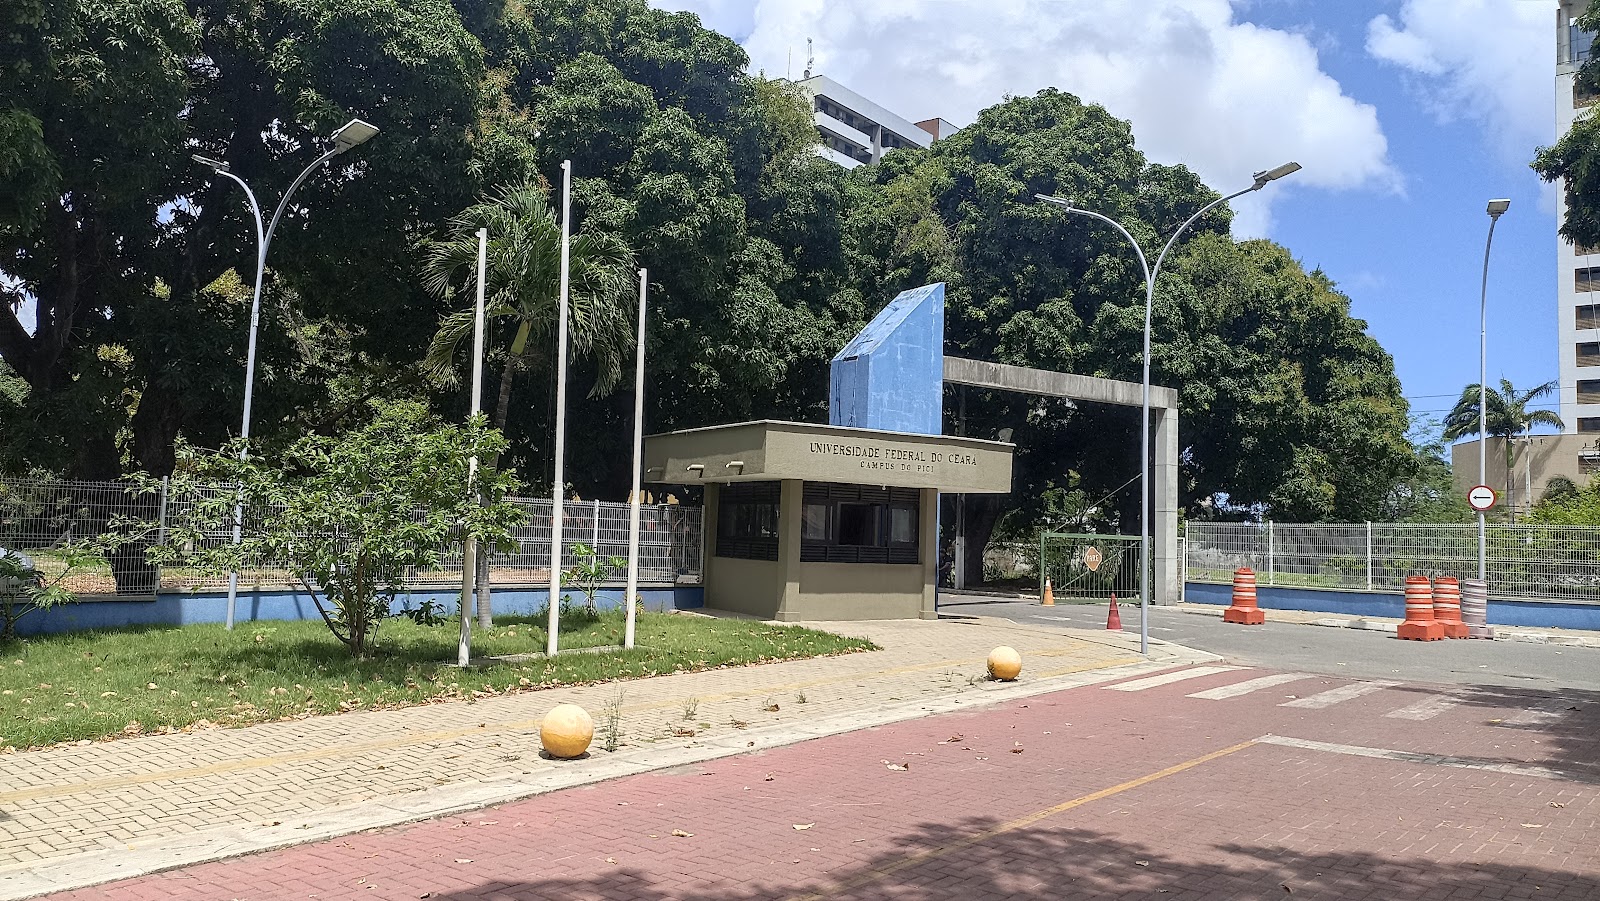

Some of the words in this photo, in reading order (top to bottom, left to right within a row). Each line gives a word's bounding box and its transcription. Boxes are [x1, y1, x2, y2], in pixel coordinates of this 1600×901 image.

[809, 442, 880, 458] UNIVERSIDADE
[885, 449, 926, 462] FEDERAL
[931, 452, 943, 463] DO
[860, 460, 895, 470] CAMPUS
[917, 464, 934, 473] PICI
